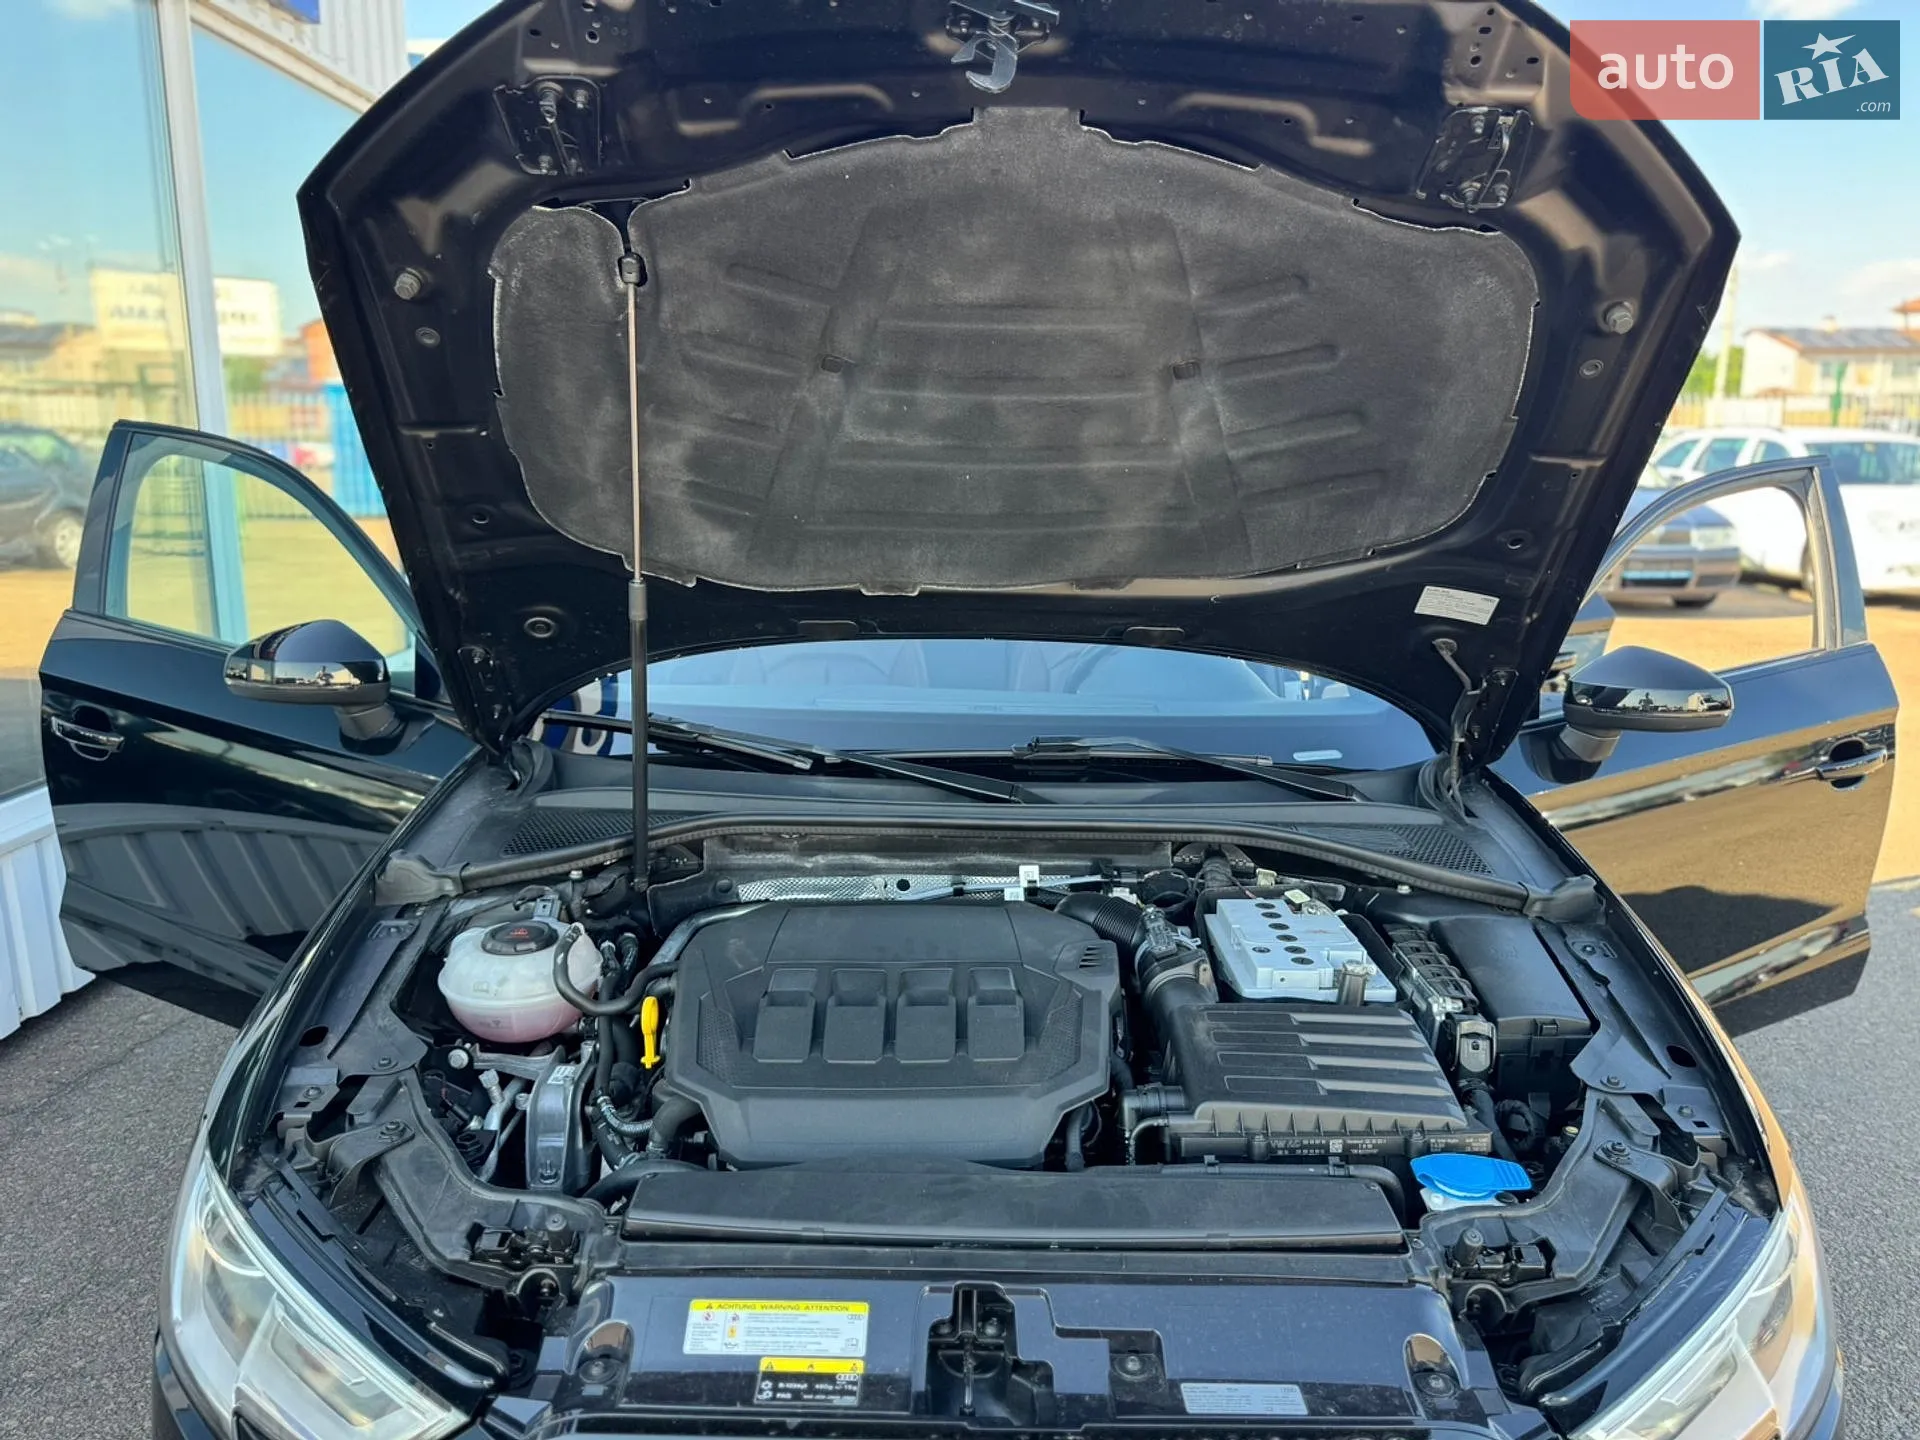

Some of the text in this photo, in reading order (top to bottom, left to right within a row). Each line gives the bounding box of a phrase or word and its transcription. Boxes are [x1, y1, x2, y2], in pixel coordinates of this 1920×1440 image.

[716, 1303, 850, 1312] ACHTUNG WARNING ATTENTION
